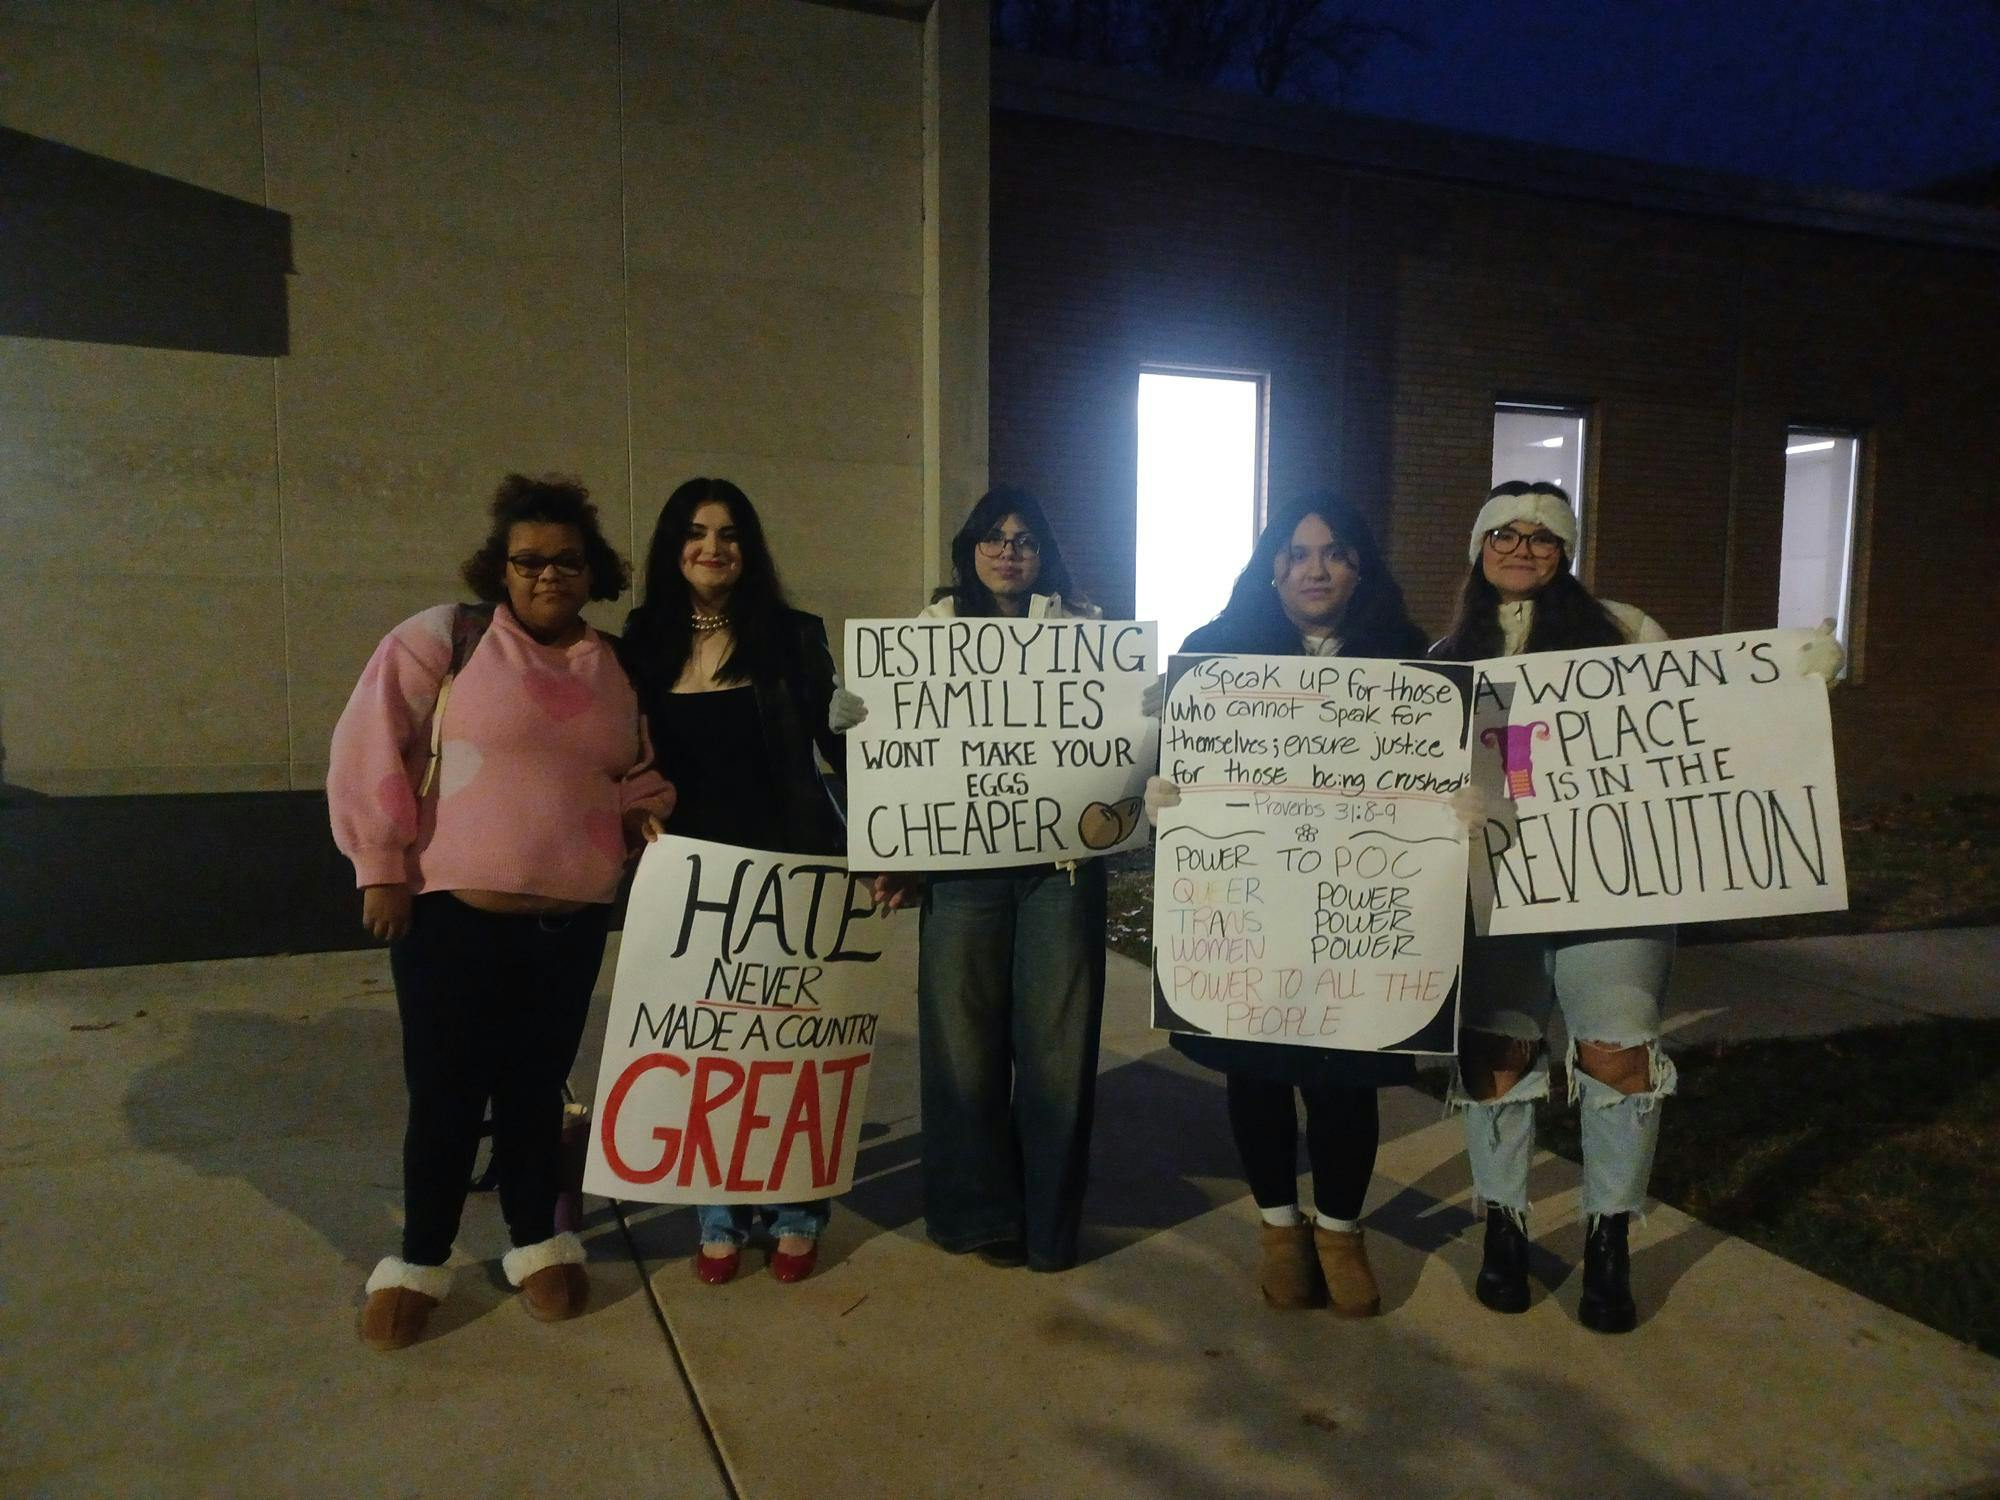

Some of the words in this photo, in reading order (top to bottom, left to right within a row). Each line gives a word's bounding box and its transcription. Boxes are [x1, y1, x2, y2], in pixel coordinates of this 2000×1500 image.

[857, 622, 1146, 678] DESTROYING
[1348, 668, 1381, 701] for
[1384, 671, 1453, 704] those
[1473, 670, 1507, 715] A
[1516, 641, 1780, 705] WOMAN'S
[893, 680, 1105, 729] FAMILIES
[1171, 694, 1216, 722] who
[1226, 697, 1304, 719] cannot
[1391, 705, 1432, 725] for
[1370, 731, 1444, 761] justice
[1555, 697, 1706, 766] PLACE
[861, 738, 940, 769] WONT
[960, 740, 1037, 766] MAKE
[1052, 737, 1136, 767] YOUR
[966, 772, 1029, 797] EGGS
[1171, 759, 1205, 784] for
[1312, 764, 1366, 797] being
[1545, 771, 1580, 802] IS
[1587, 763, 1633, 797] IN
[1646, 747, 1735, 788] THE
[867, 797, 1068, 857] CHEAPER
[1335, 801, 1397, 824] 31:8-9
[1176, 845, 1257, 872] POWER
[1277, 848, 1321, 873] TO
[1335, 846, 1422, 879] POC
[1483, 785, 1829, 909] REVOLUTION
[670, 854, 883, 964] HATE
[1317, 882, 1413, 910] POWER
[1168, 907, 1263, 937] TRANS
[1314, 909, 1414, 935] POWER
[1171, 935, 1265, 963] WOMEN
[1311, 934, 1422, 963] POWER
[704, 958, 823, 1008] NEVER
[1172, 965, 1264, 1001] POWER
[1272, 968, 1303, 999] TO
[1314, 968, 1365, 1000] ALL
[1376, 971, 1445, 1002] THE
[628, 1002, 738, 1051] MADE
[740, 1010, 769, 1051] A
[776, 1013, 879, 1049] COUNTRY
[1225, 1001, 1345, 1038] PEOPLE
[600, 1053, 871, 1192] GREAT
